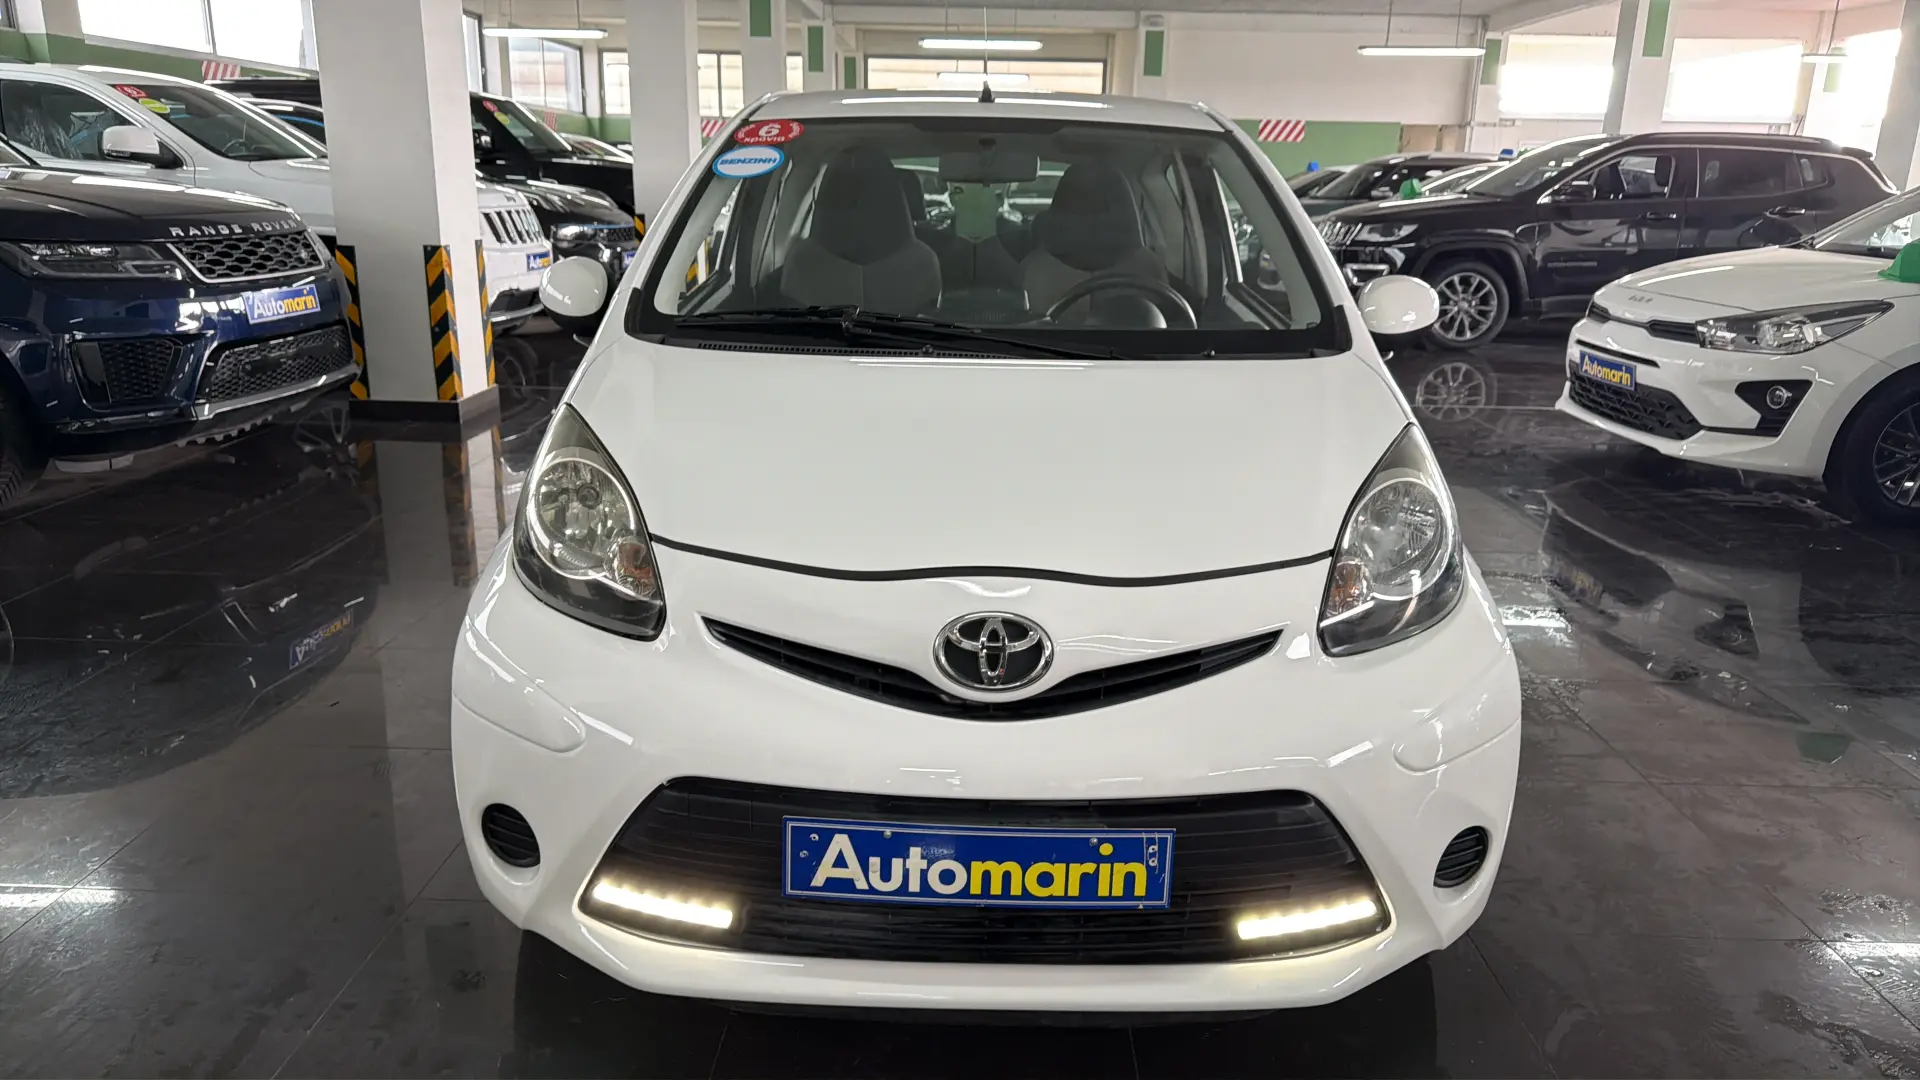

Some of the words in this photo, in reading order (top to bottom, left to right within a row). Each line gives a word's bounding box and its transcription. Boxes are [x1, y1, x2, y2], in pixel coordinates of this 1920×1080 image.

[758, 123, 781, 138] 6
[169, 223, 243, 237] RANGE
[251, 219, 297, 232] ROVER
[253, 288, 317, 319] Automarin
[1582, 354, 1631, 386] Automarin
[810, 833, 1147, 897] Automarin
